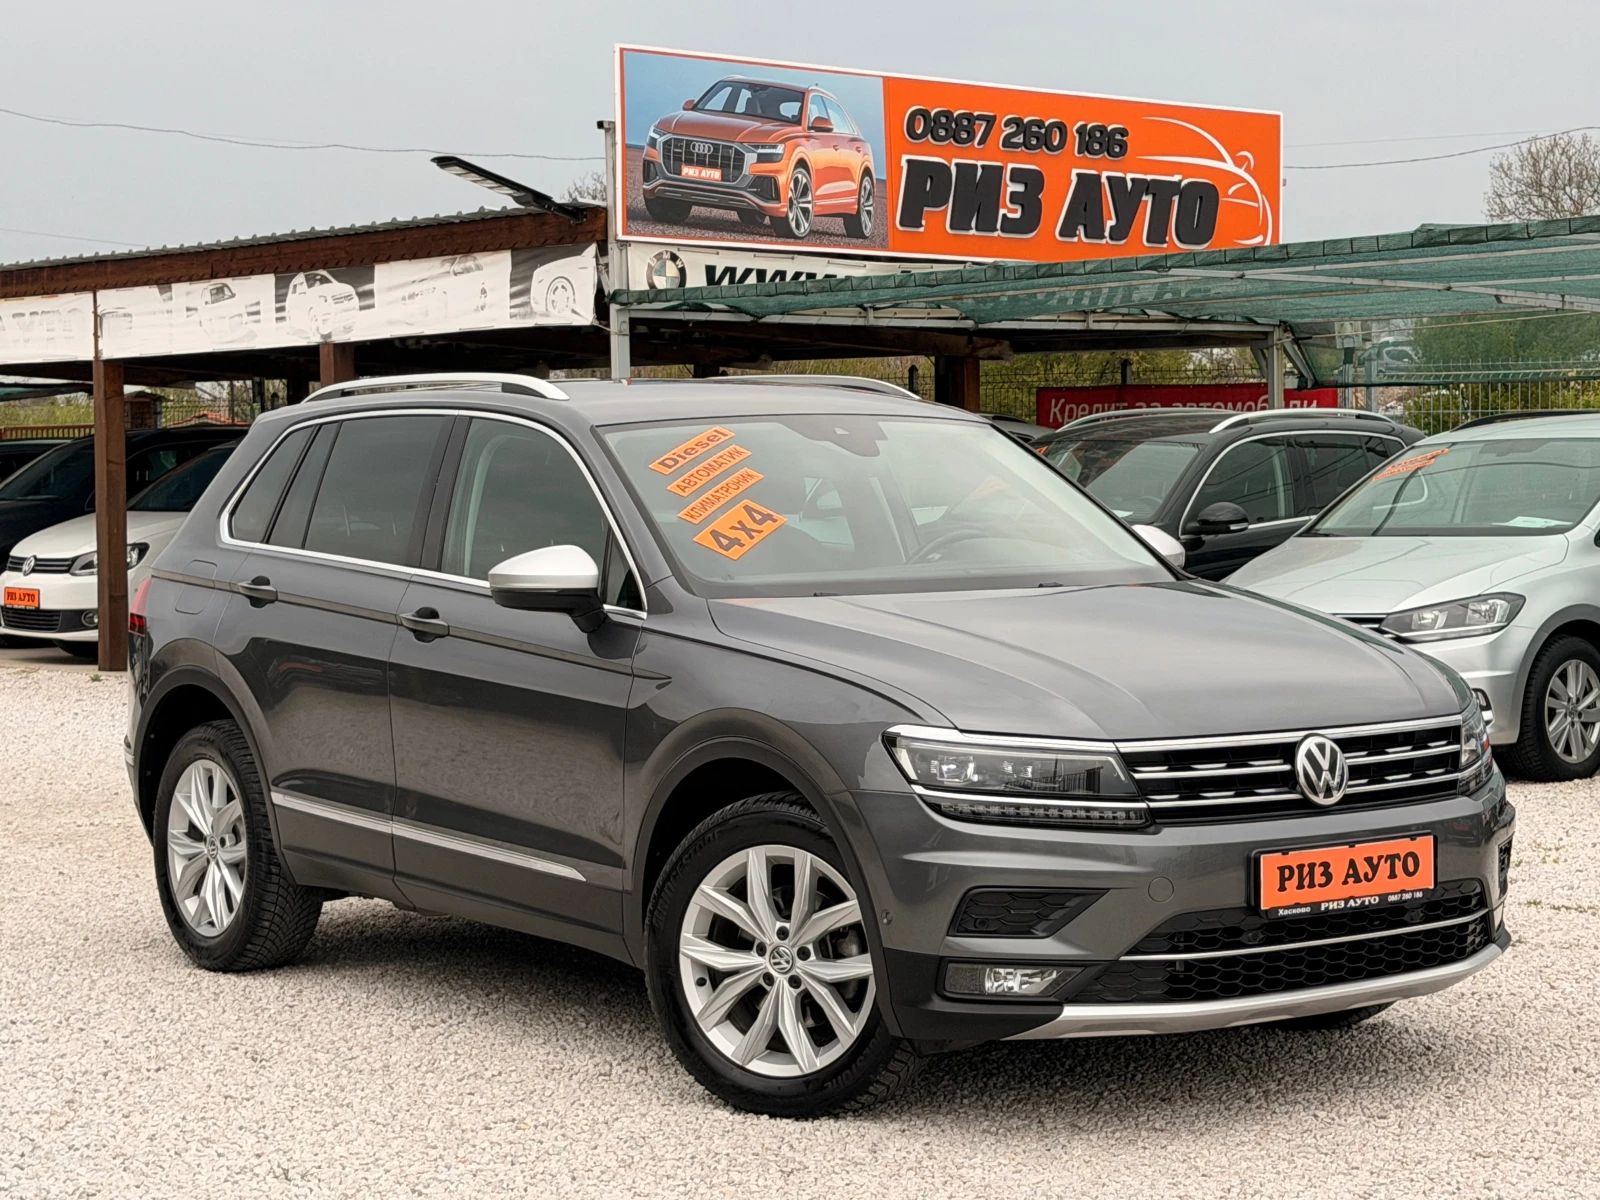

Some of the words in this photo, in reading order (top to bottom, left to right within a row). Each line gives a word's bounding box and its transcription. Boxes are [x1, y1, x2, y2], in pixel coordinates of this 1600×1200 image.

[905, 106, 996, 148] 0887
[1000, 115, 1067, 154] 260
[1073, 122, 1129, 160] 186
[700, 169, 720, 179] АУТО
[896, 154, 1045, 238] РИЗ
[1055, 168, 1220, 249] АУТО
[656, 428, 729, 470] Diesel
[675, 447, 746, 494] АВТОМАТИК
[684, 470, 757, 521] КЛИМАТРОНИК
[1276, 861, 1333, 892] РИЗ
[1341, 851, 1420, 886] АУТО
[1278, 907, 1311, 916] Хасково
[1320, 901, 1345, 911] РИЗ
[1346, 896, 1380, 908] АУТО
